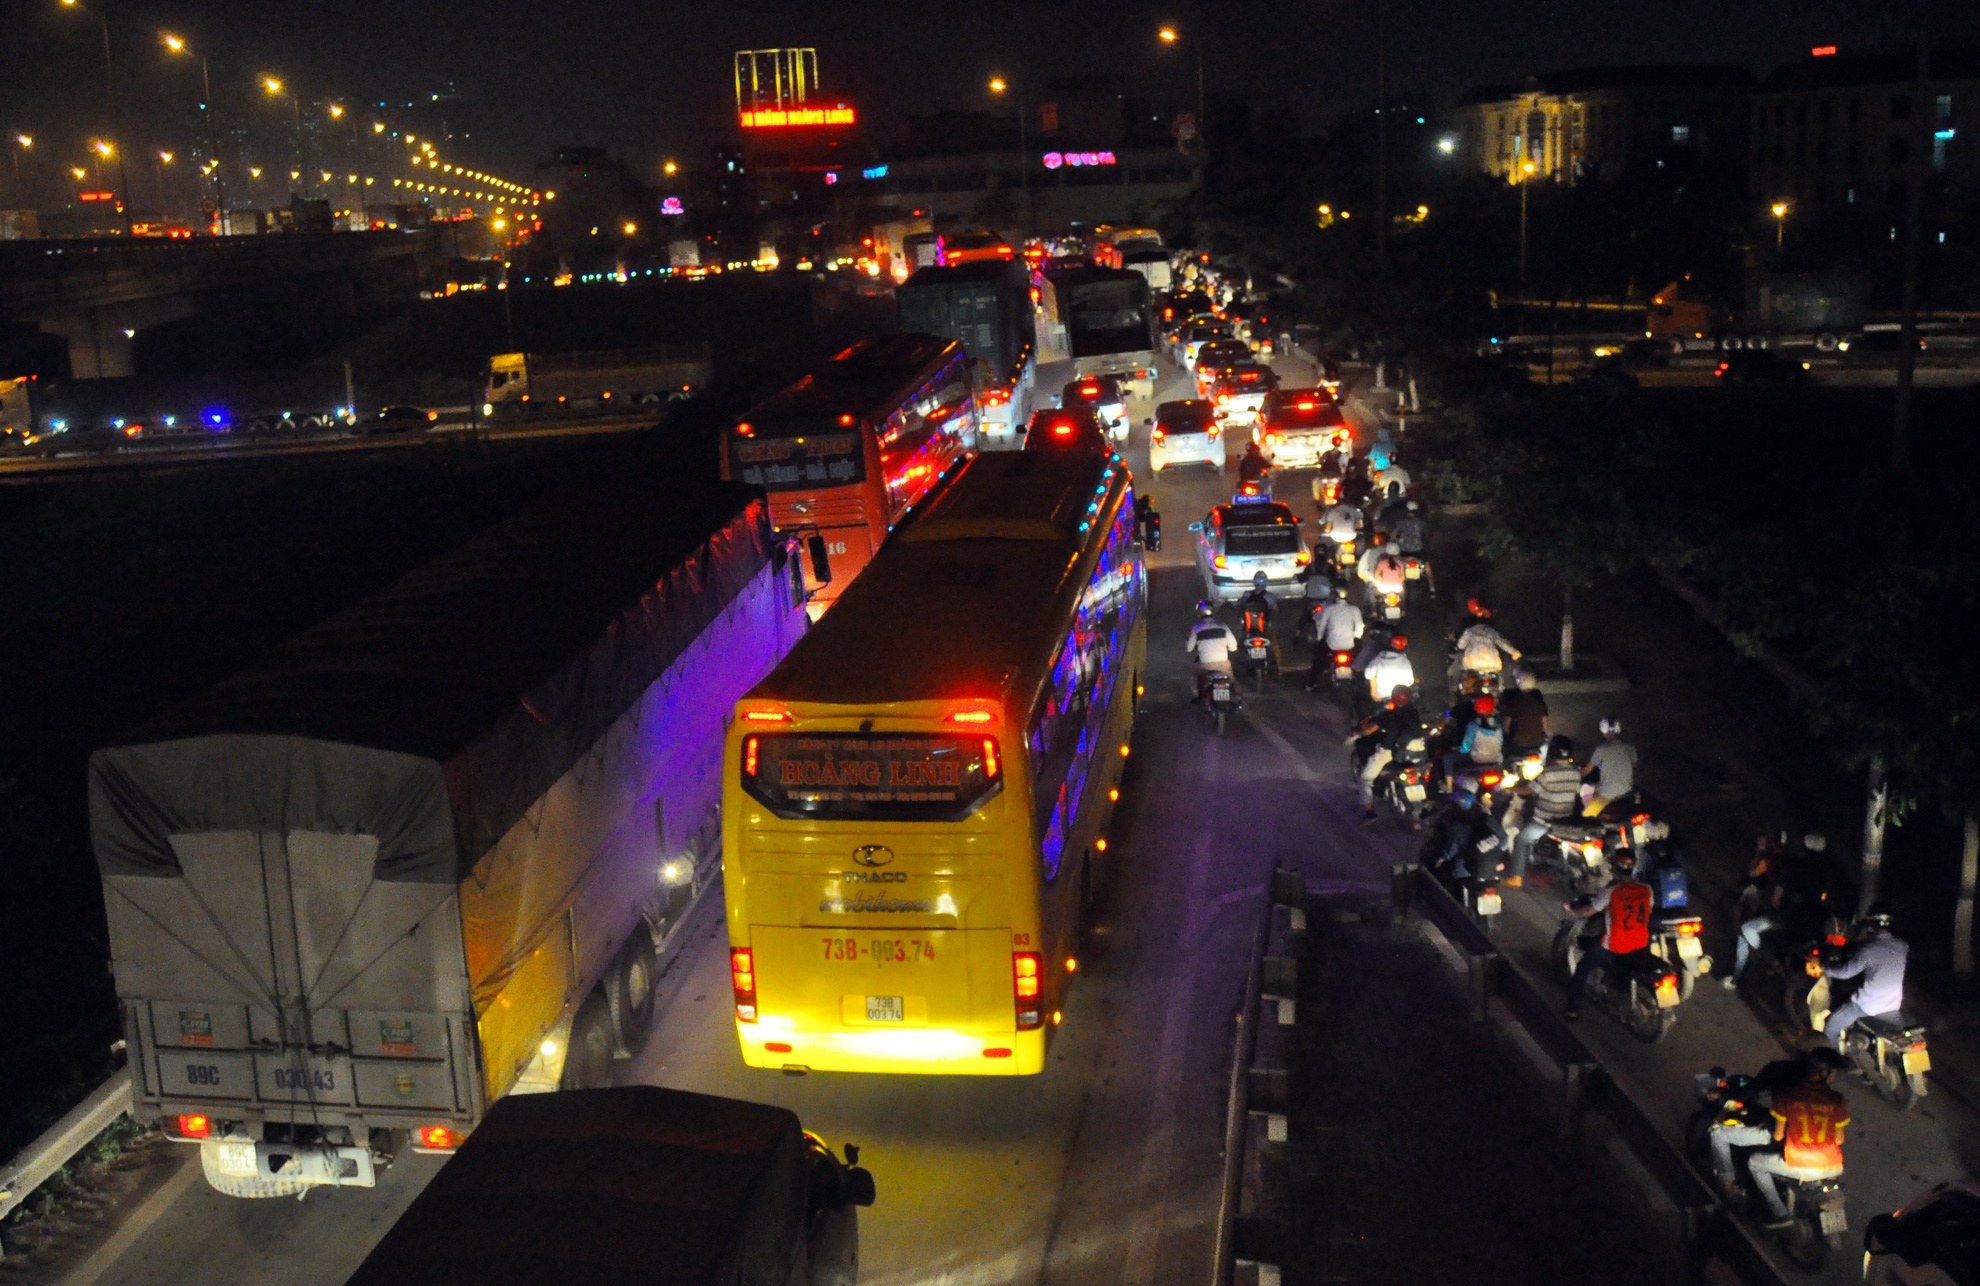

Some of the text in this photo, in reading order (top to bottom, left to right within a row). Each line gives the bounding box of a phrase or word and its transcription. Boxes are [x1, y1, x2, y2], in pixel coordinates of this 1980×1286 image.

[779, 752, 961, 786] HOÀNG LINH
[842, 871, 908, 883] THACO
[186, 1064, 220, 1085] 89C
[1799, 1112, 1829, 1144] 17
